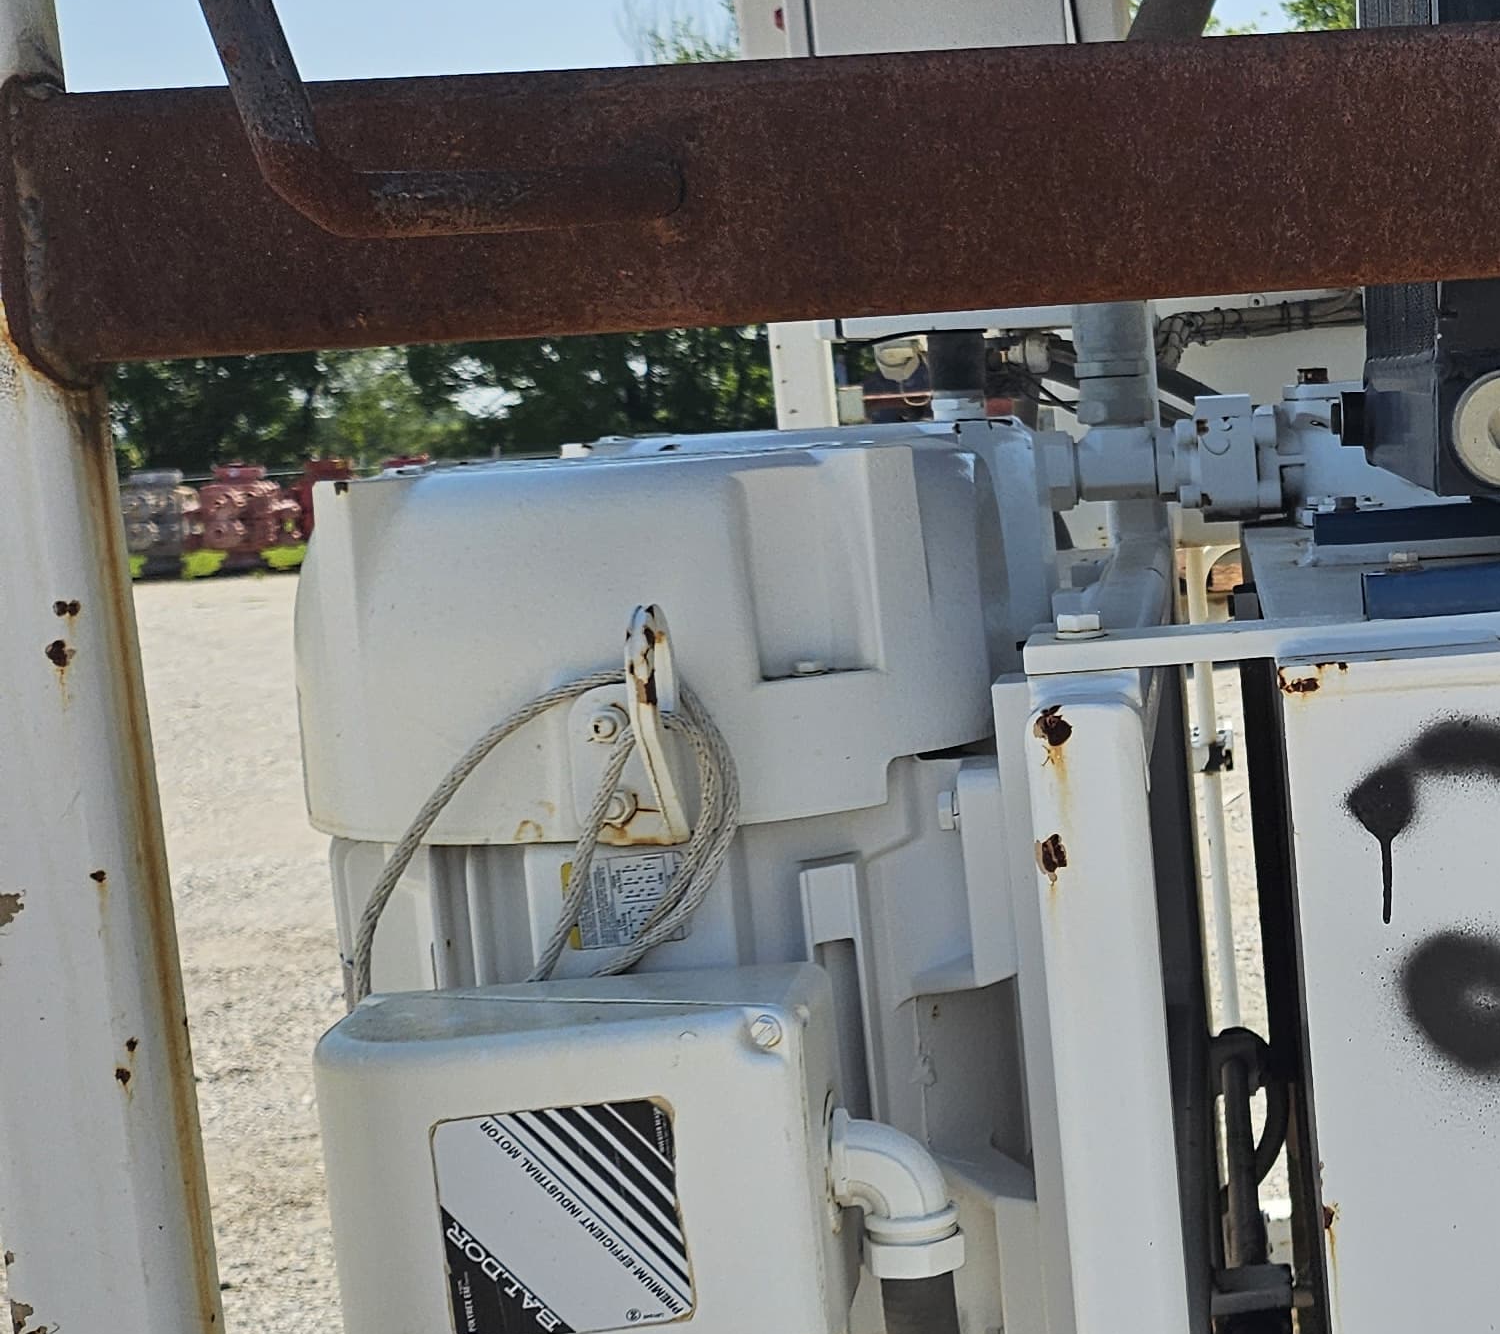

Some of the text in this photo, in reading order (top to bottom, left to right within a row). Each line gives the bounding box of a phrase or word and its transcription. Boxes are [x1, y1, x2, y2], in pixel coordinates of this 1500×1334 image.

[446, 1221, 561, 1332] BALDOR
[480, 1121, 685, 1315] PREMIUM-EFFICIENT INDUSTRIAL MOTOR
